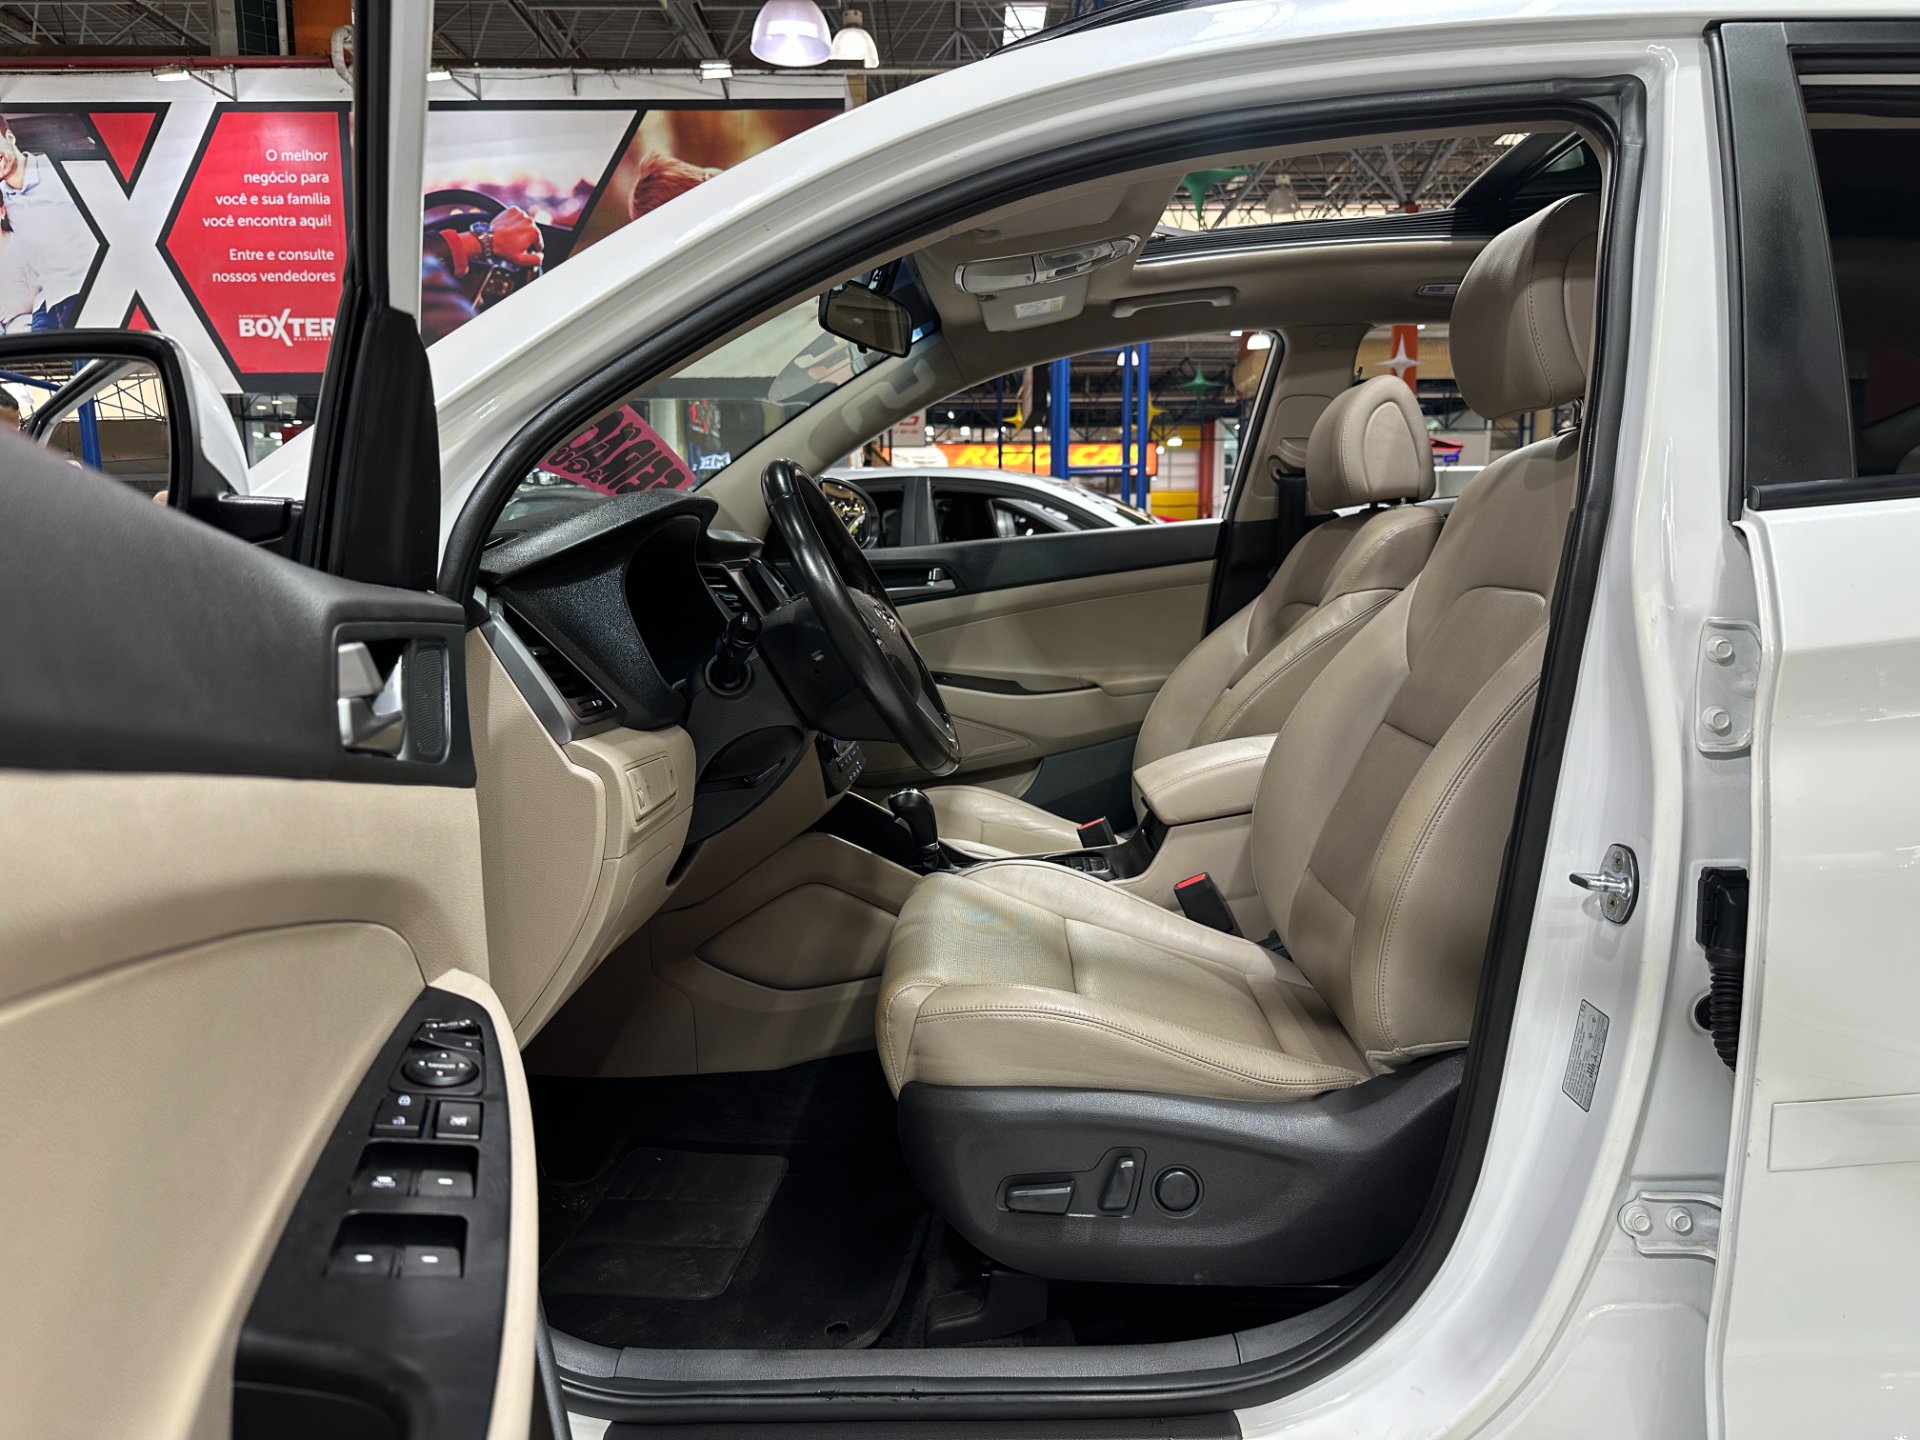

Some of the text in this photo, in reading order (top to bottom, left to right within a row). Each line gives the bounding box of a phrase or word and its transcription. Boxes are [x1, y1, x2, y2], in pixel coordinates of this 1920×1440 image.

[265, 149, 328, 162] O melhor
[243, 171, 330, 186] negócio para
[215, 192, 331, 205] você e sua família
[202, 214, 332, 230] você encontra aqui!
[229, 248, 335, 261] Entre e consulte
[212, 270, 336, 283] nossos vendedores
[238, 308, 335, 347] BOXTER
